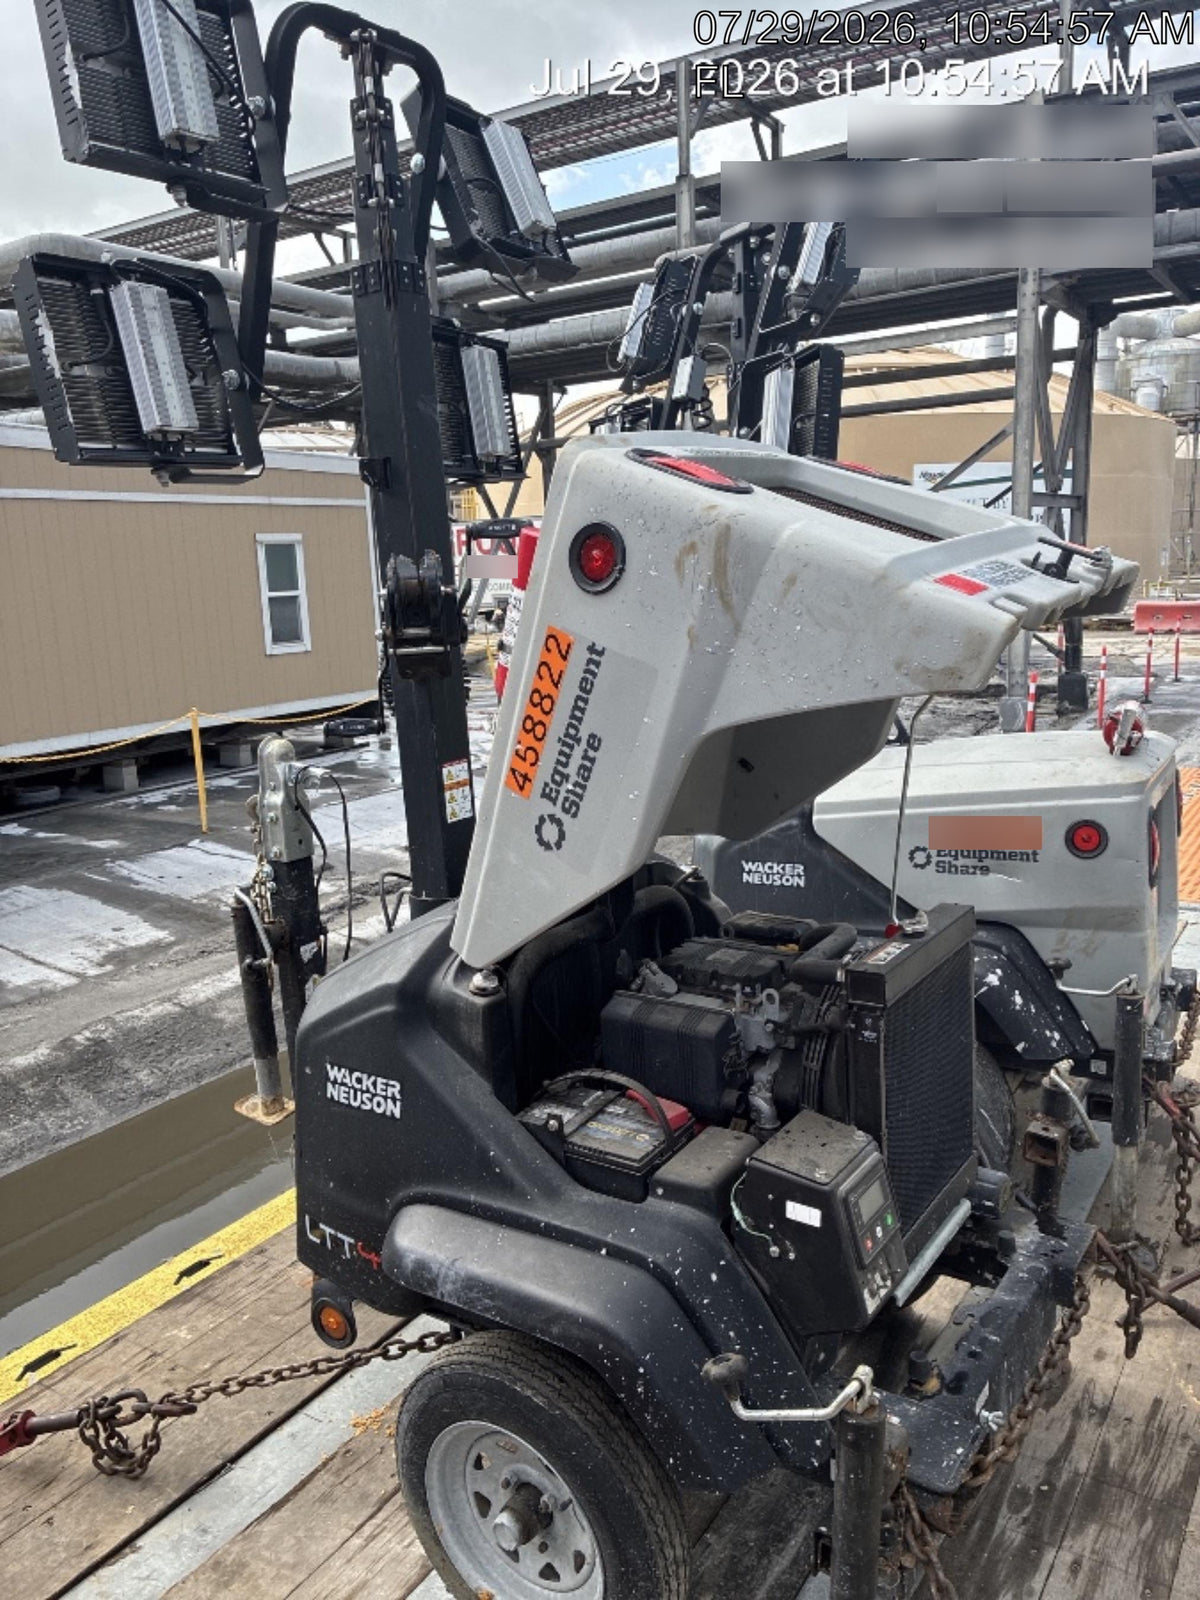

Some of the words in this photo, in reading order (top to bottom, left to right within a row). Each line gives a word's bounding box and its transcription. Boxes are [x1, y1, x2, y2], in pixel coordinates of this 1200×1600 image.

[510, 633, 571, 792] 458822
[540, 642, 606, 806] Equipment
[561, 732, 603, 818] Share
[741, 860, 805, 876] WACKER
[935, 849, 1040, 863] Equipment
[935, 860, 991, 875] Share
[742, 872, 805, 888] NEUSON
[326, 1062, 401, 1100] WACKER
[326, 1081, 401, 1119] NEUSON
[305, 1213, 382, 1270] LTT4
